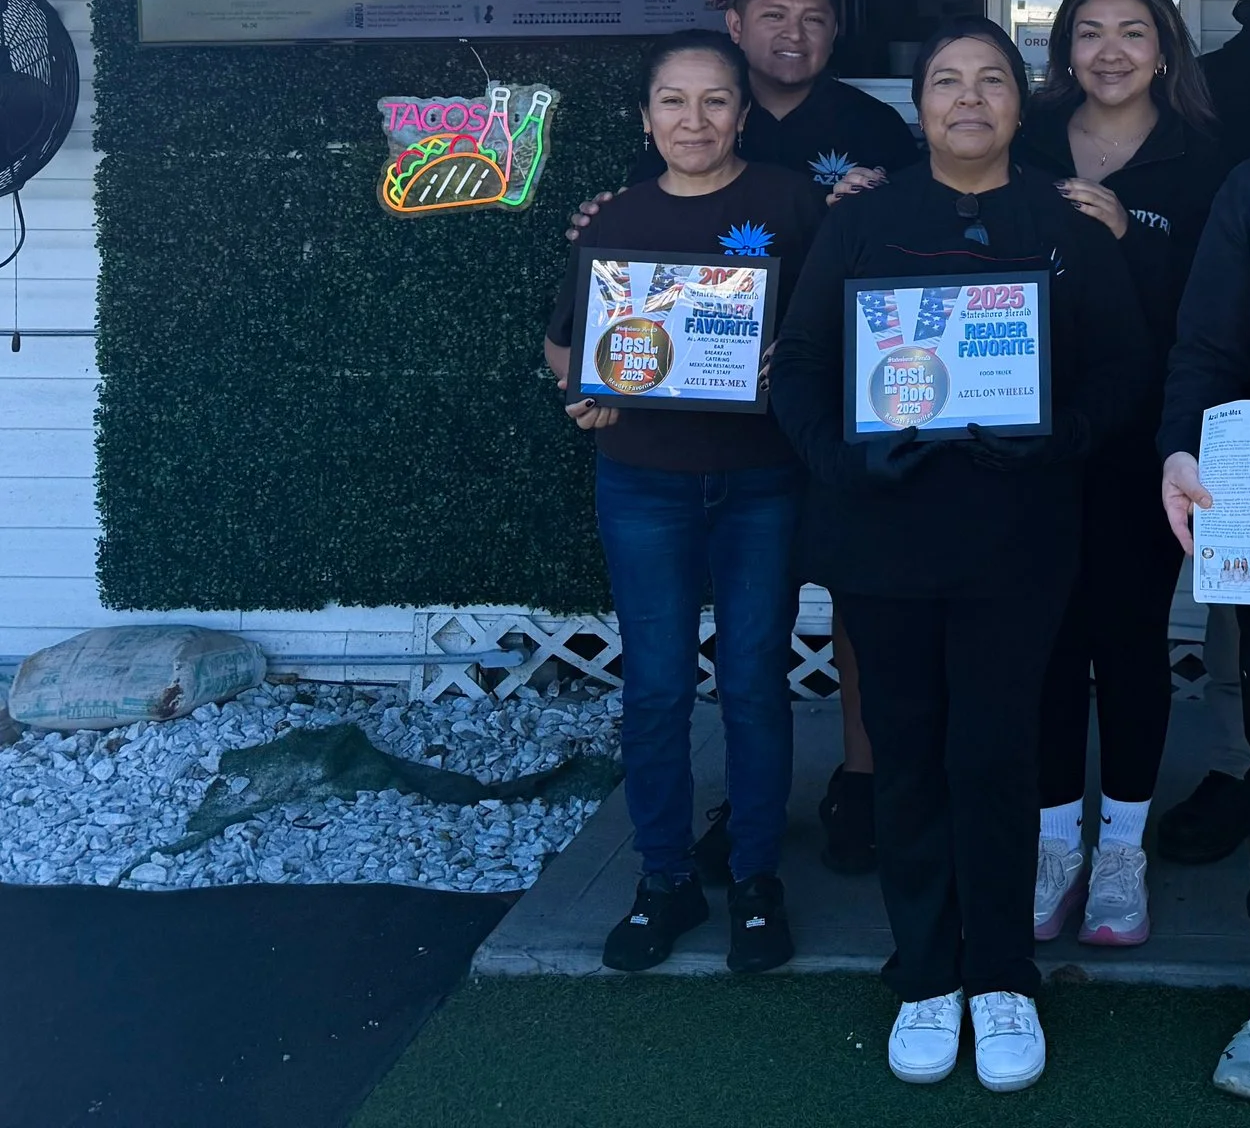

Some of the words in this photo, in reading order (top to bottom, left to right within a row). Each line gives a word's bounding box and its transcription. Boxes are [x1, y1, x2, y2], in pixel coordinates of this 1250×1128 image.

[354, 2, 364, 29] MENU
[383, 103, 488, 132] TACOS
[966, 285, 1025, 311] 2025
[692, 301, 754, 321] READER
[960, 310, 1003, 320] Statesboro
[1004, 308, 1032, 320] Herald
[684, 318, 760, 338] FAVORITE
[964, 321, 1028, 340] READER
[610, 333, 651, 354] Best
[958, 338, 1036, 358] FAVORITE
[624, 353, 658, 371] Boro
[620, 370, 645, 382] 2025
[684, 377, 708, 386] AZUL
[709, 378, 747, 388] TEX-MEX
[883, 365, 926, 386] Best
[926, 374, 934, 384] of
[884, 385, 898, 395] the
[899, 385, 935, 403] Boro
[958, 389, 982, 399] AZUL
[983, 388, 997, 397] ON
[997, 387, 1035, 397] WHEELS
[896, 402, 922, 415] 2025
